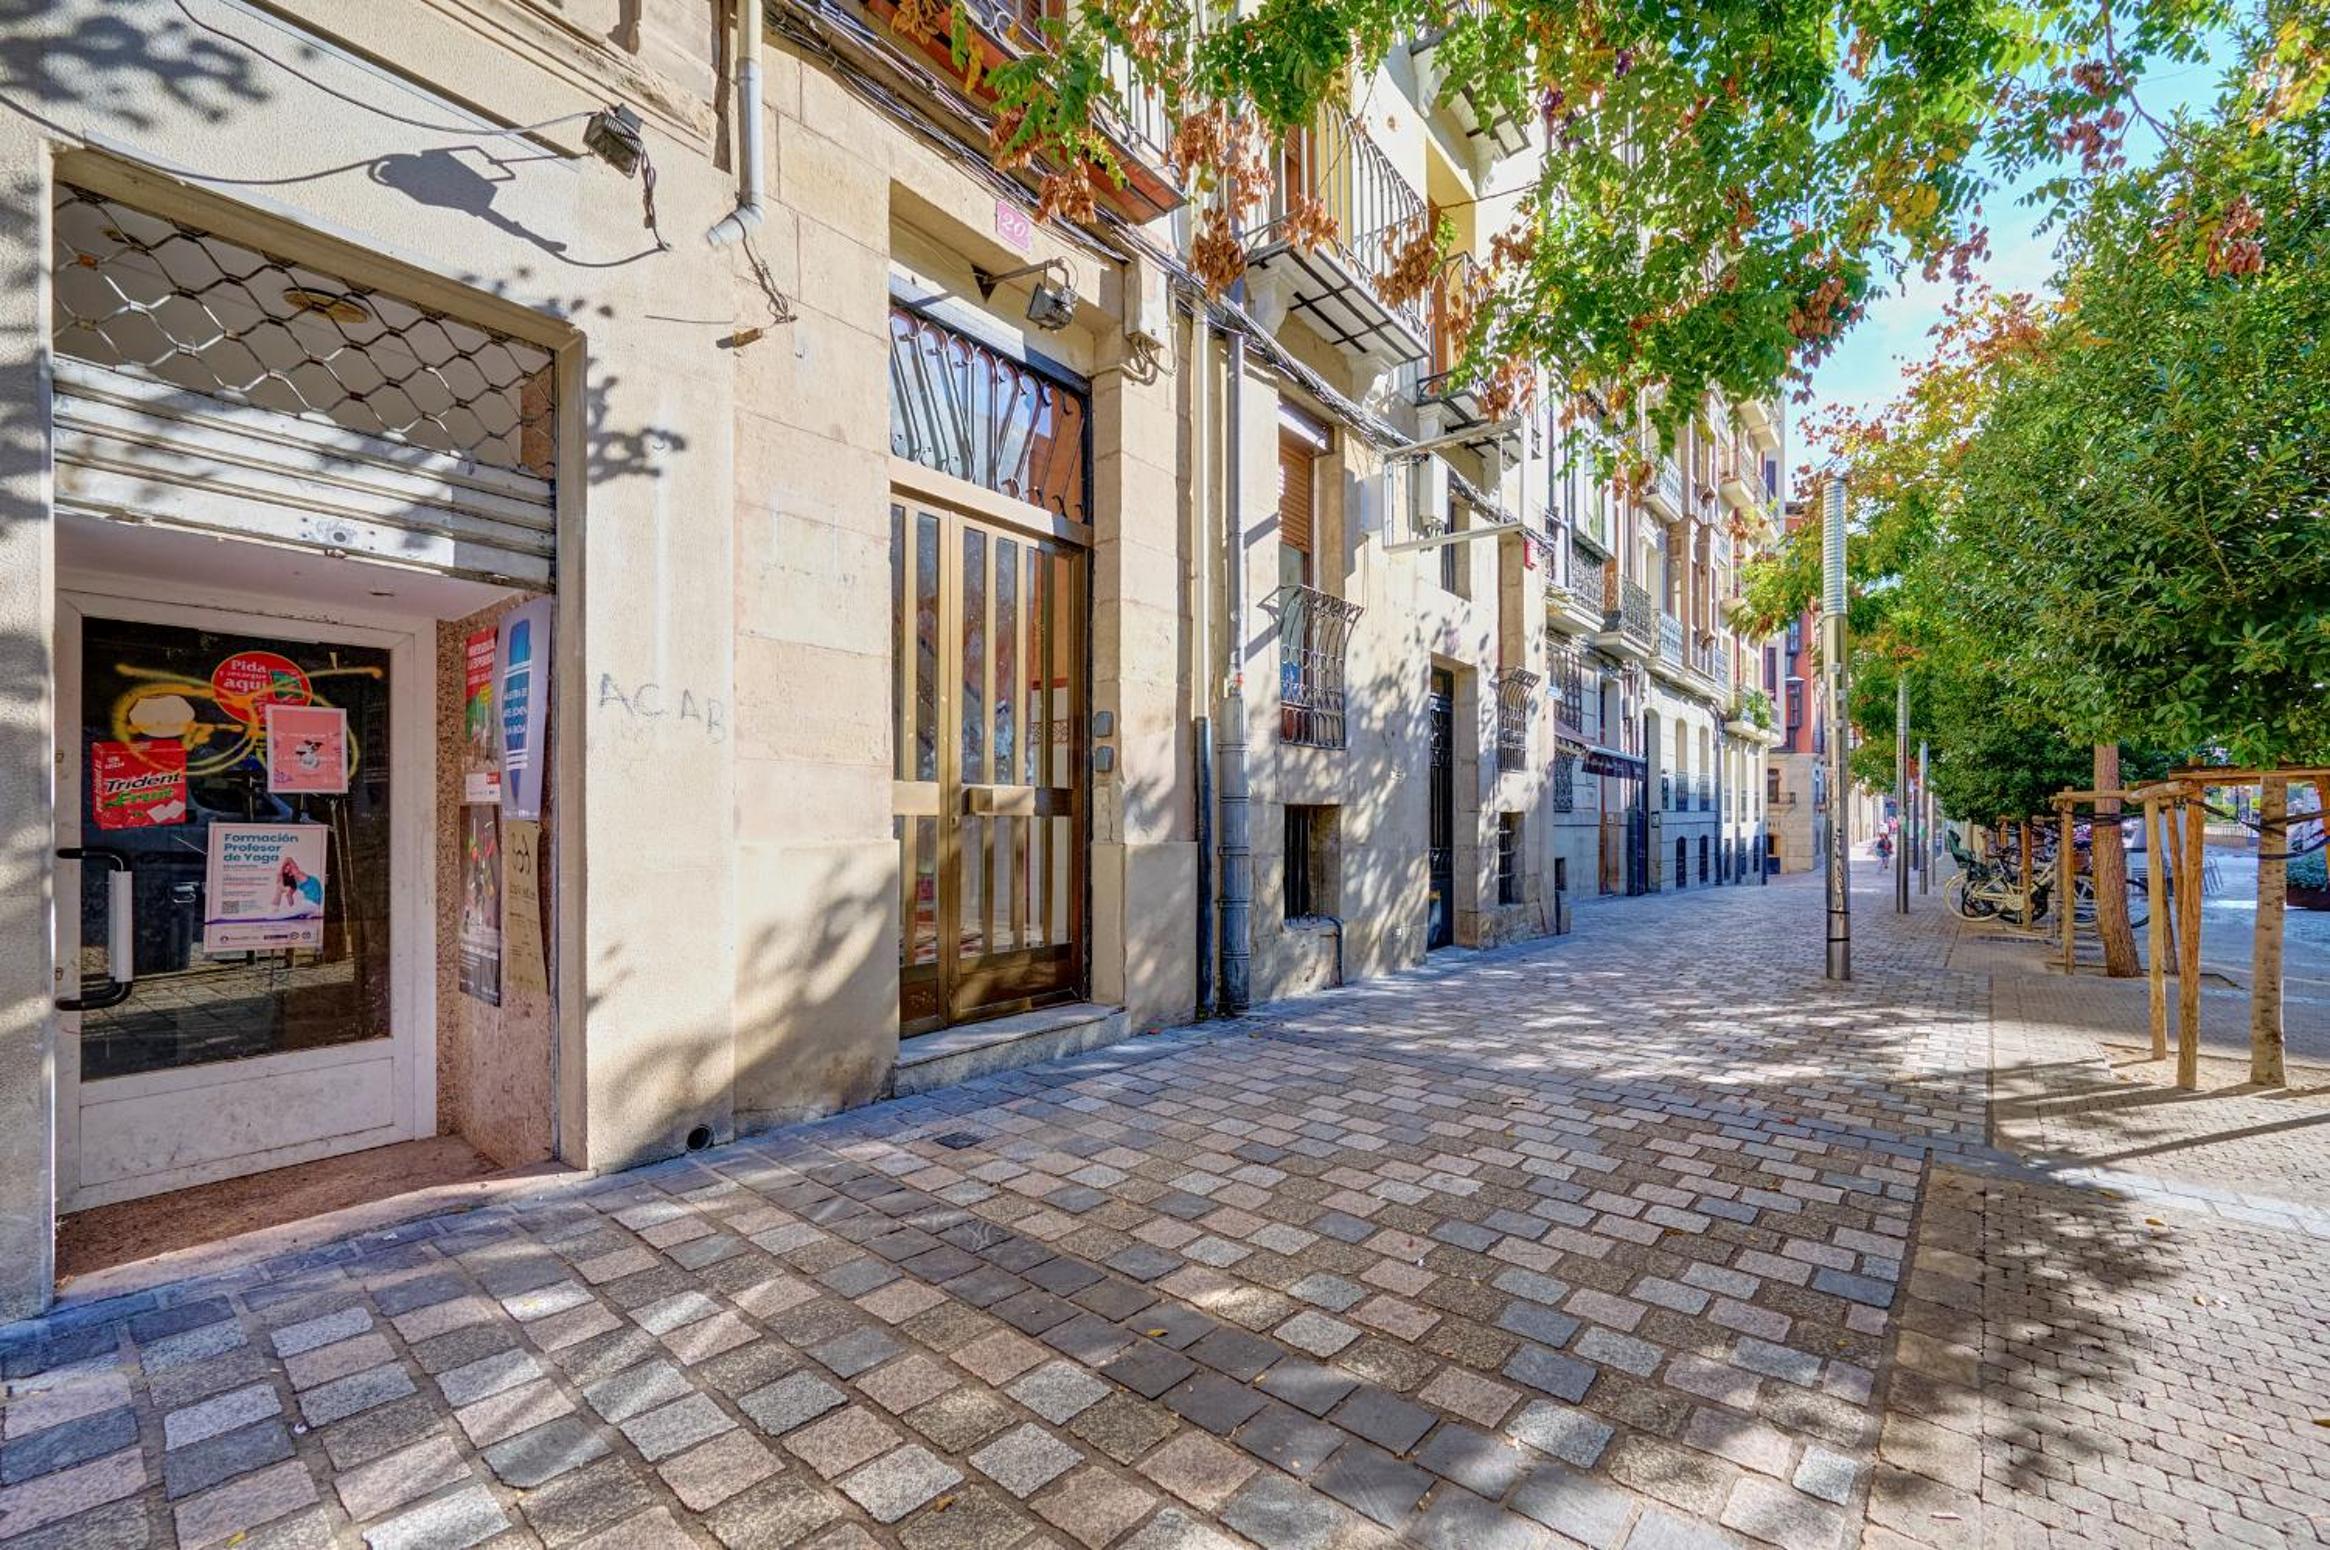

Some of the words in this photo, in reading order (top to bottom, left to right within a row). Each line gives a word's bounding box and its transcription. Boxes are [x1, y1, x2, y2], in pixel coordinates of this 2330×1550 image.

[1002, 212, 1026, 237] 20
[231, 660, 267, 673] Pida
[106, 770, 182, 793] Trident
[224, 832, 299, 843] Formación
[224, 842, 282, 852] Profesor
[223, 853, 241, 862] de
[244, 853, 279, 865] Yoga
